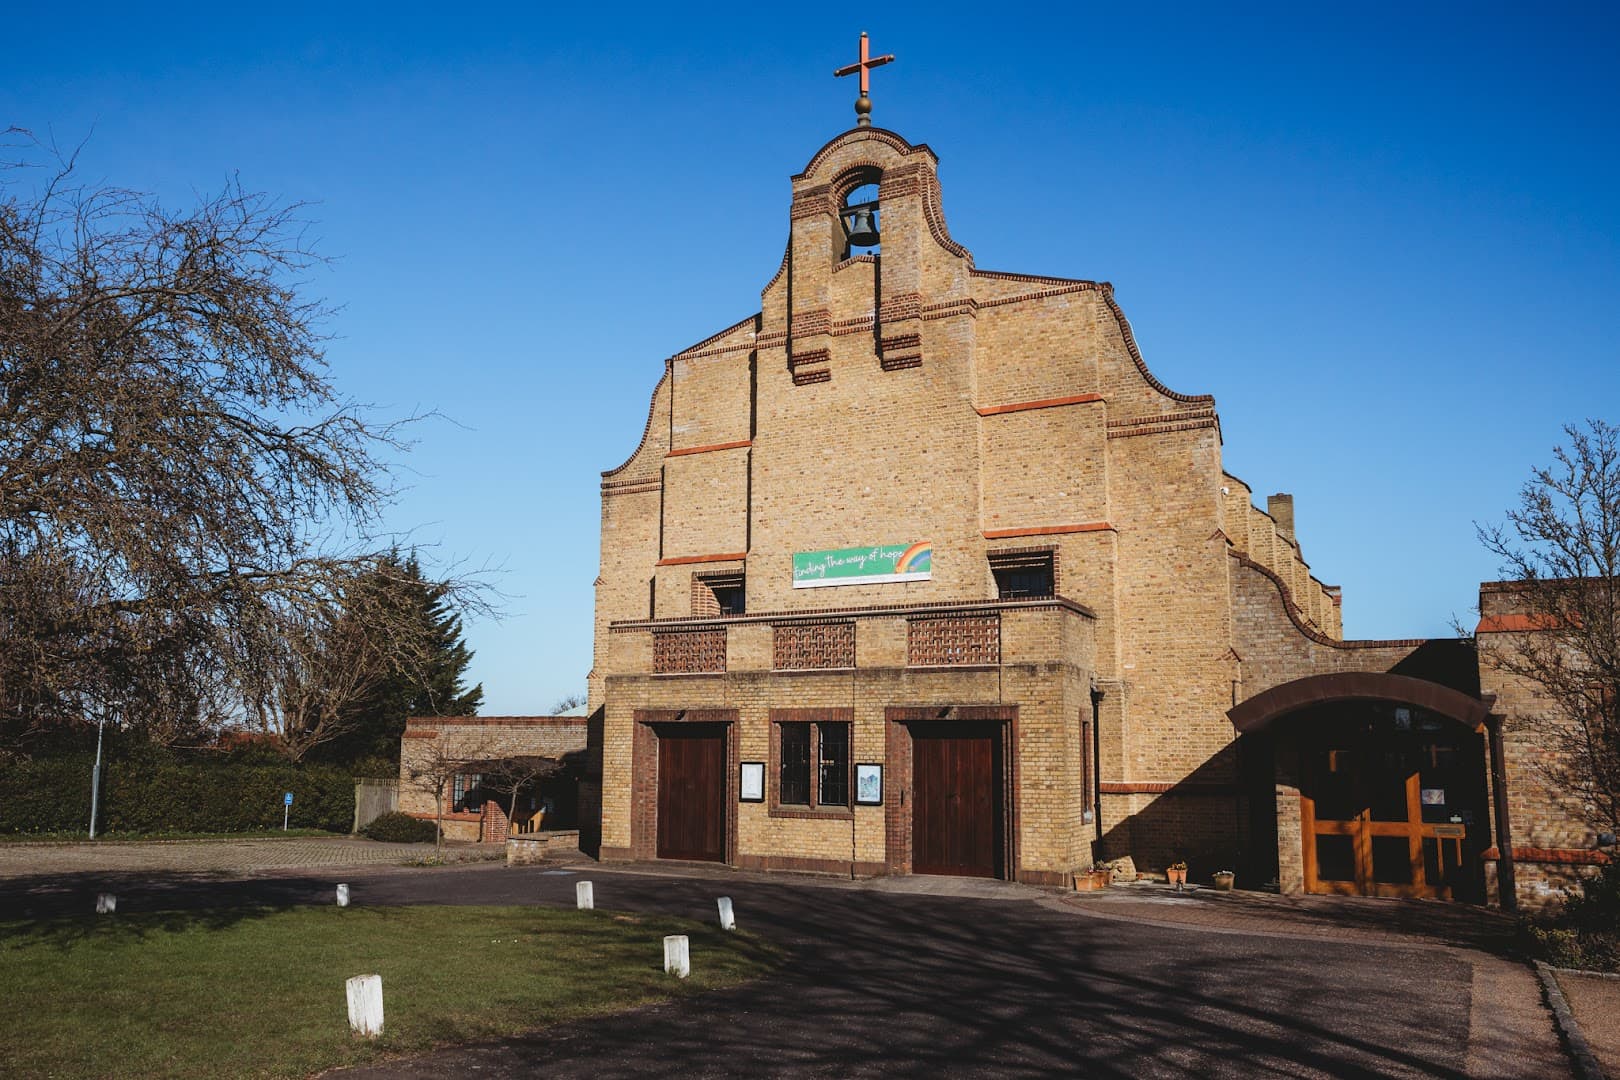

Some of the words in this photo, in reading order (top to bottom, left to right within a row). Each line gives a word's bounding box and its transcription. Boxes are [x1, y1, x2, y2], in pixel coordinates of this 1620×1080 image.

[794, 562, 825, 578] finding
[847, 555, 866, 568] way
[868, 547, 879, 561] of
[880, 546, 904, 565] hope
